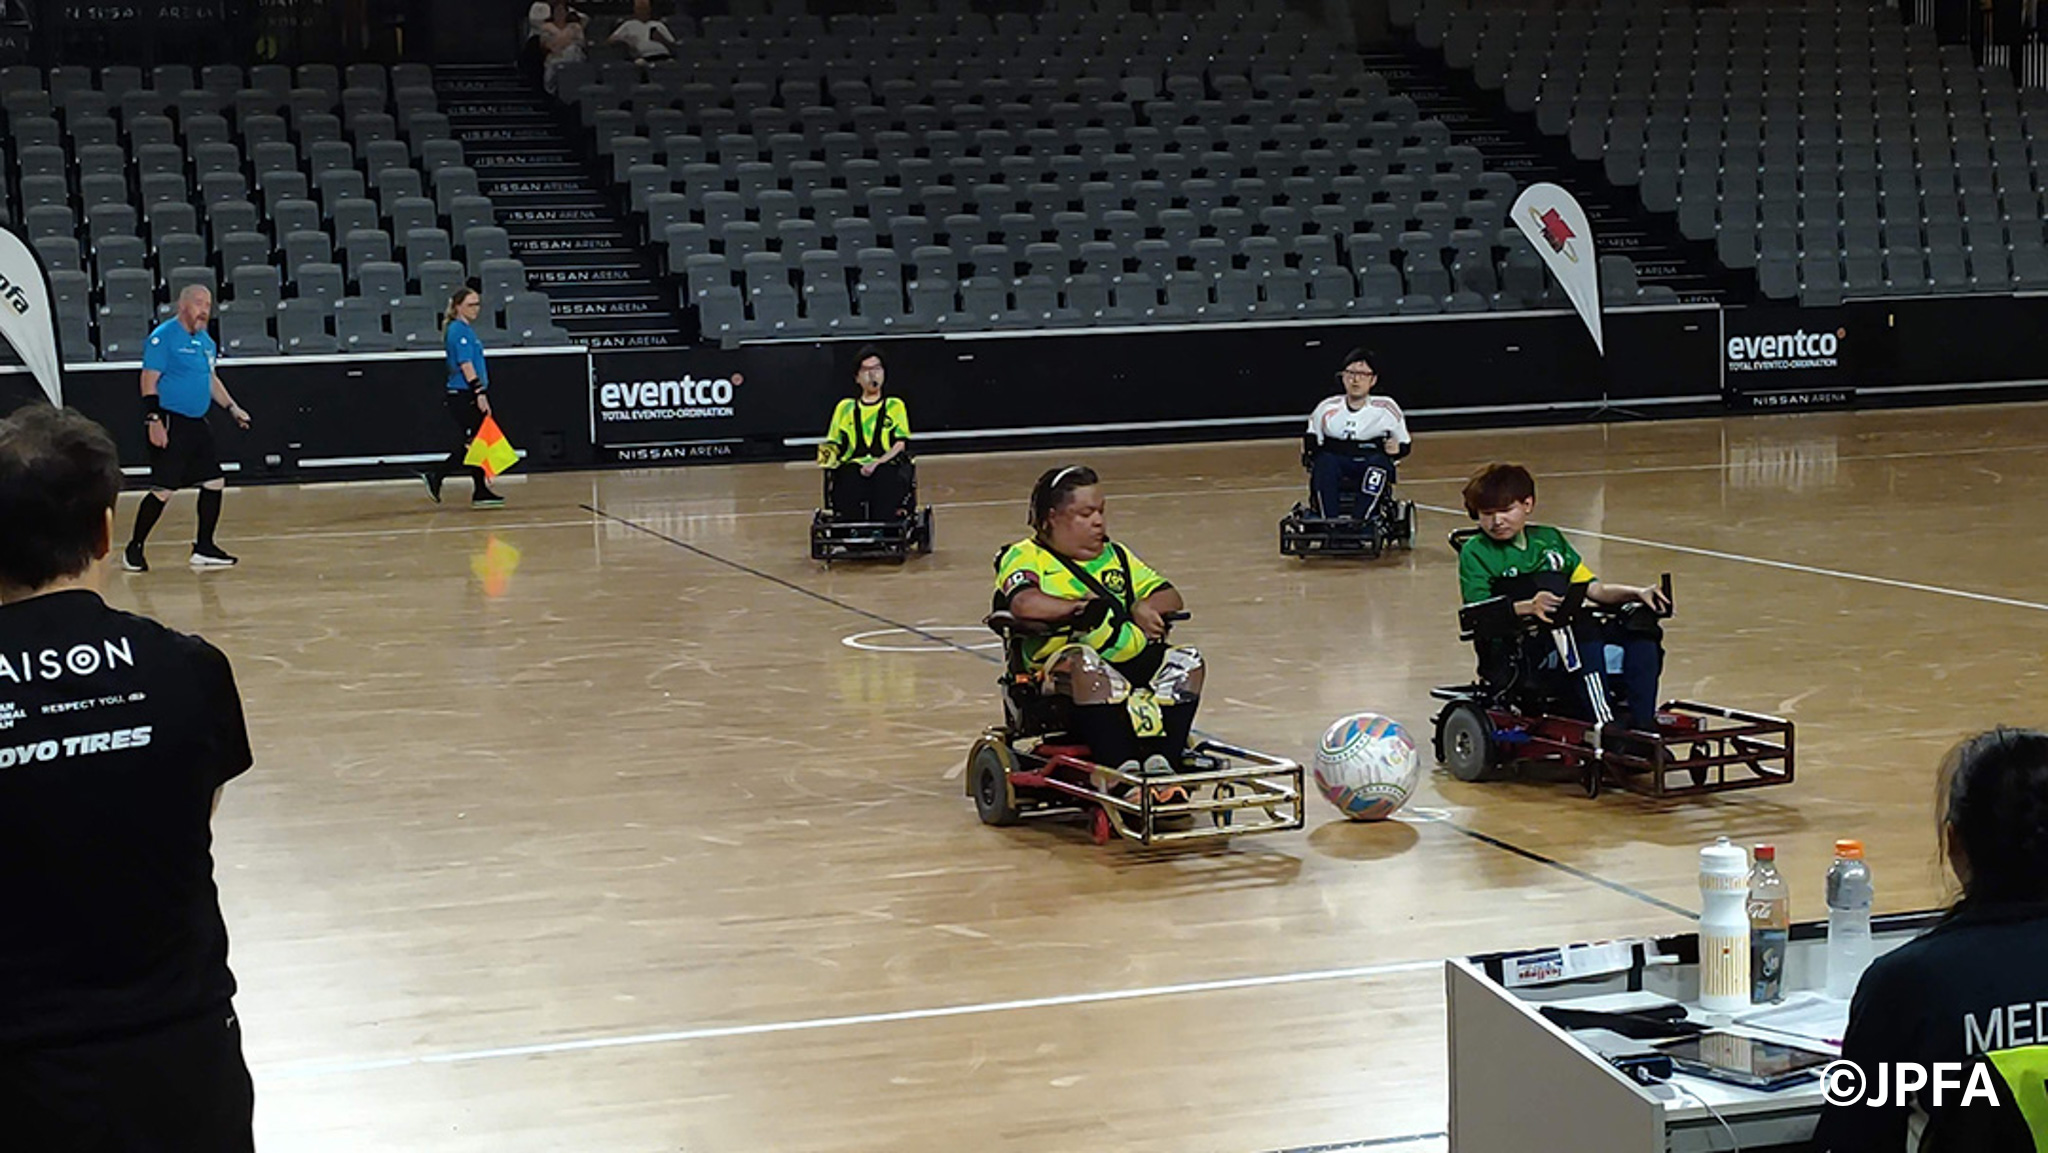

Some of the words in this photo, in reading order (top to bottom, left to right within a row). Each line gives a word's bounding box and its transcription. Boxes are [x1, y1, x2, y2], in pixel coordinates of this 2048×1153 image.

[591, 270, 630, 281] ARENA
[609, 303, 649, 313] ARENA
[627, 335, 668, 346] ARENA
[1727, 329, 1838, 360] eventco
[600, 374, 734, 409] eventco
[1752, 395, 1809, 406] NISSAN
[1811, 393, 1847, 403] ARENA
[601, 410, 631, 421] TOTAL
[618, 448, 687, 460] NISSAN
[688, 445, 732, 457] ARENA
[41, 699, 96, 714] RESPECT
[1138, 704, 1154, 732] 5
[62, 725, 153, 758] TIRES
